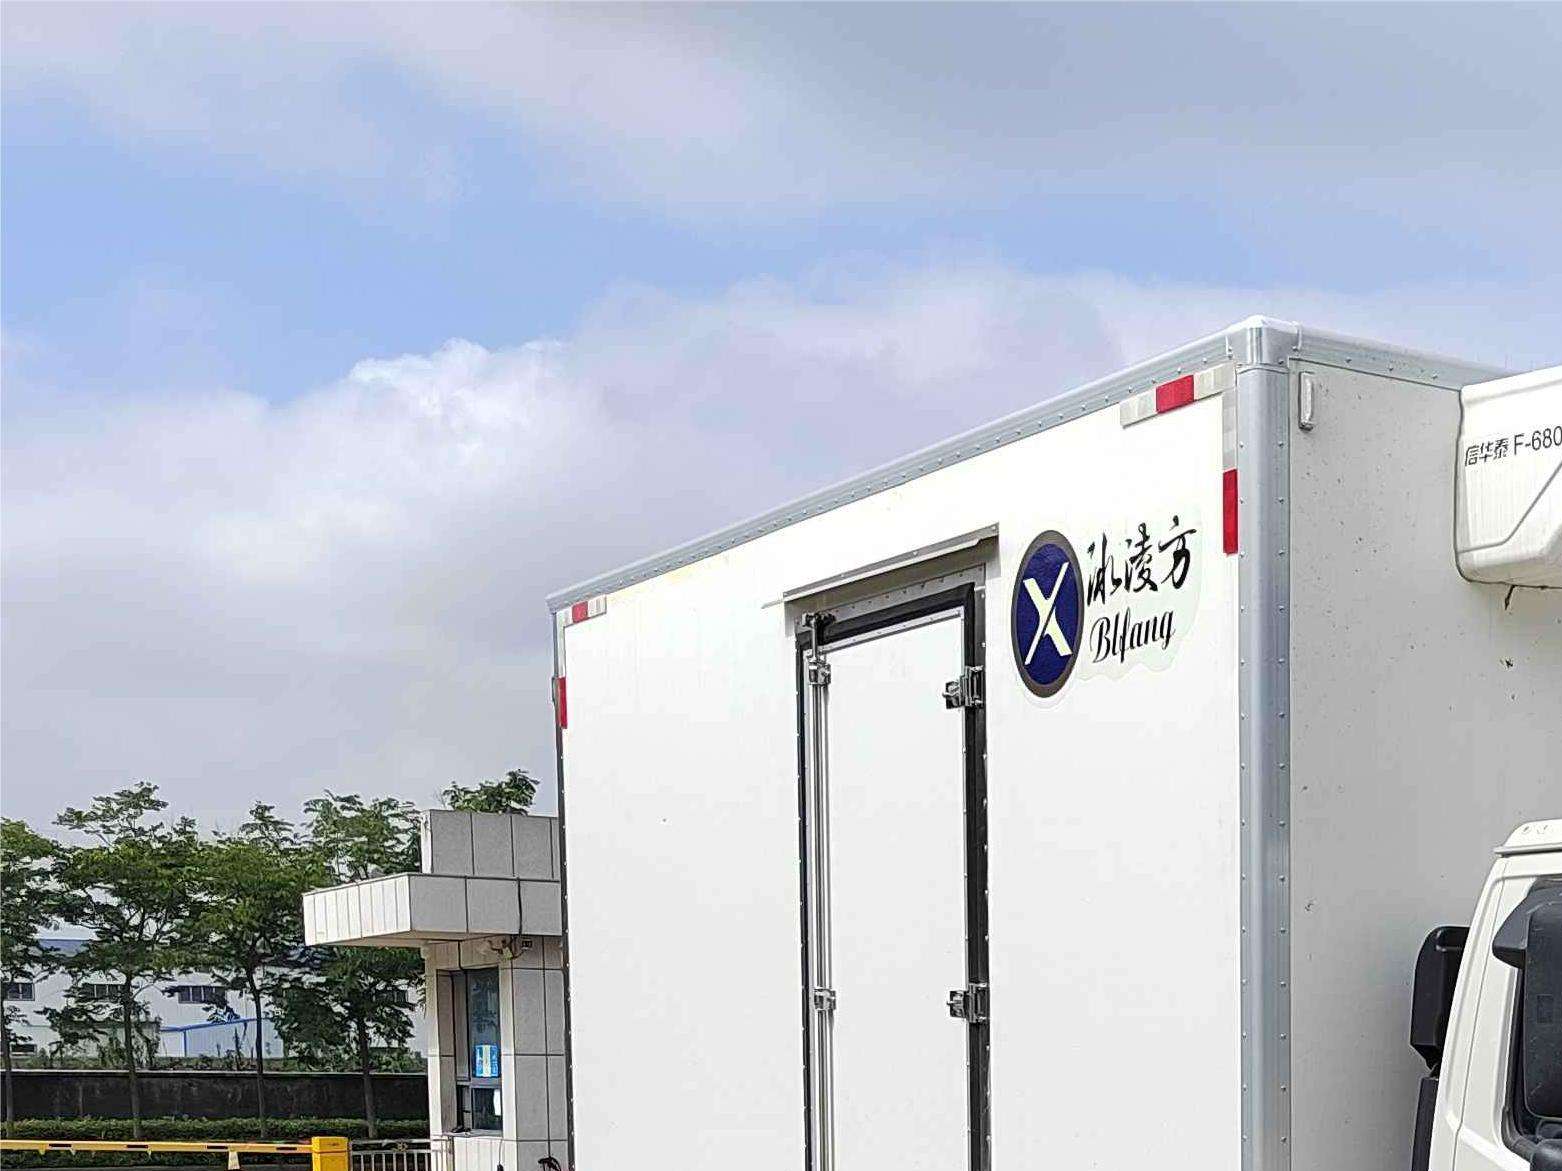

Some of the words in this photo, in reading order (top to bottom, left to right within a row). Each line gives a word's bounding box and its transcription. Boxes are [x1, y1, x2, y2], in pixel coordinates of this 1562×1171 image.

[1464, 437, 1509, 467] 信华泰
[1514, 425, 1562, 455] F-680
